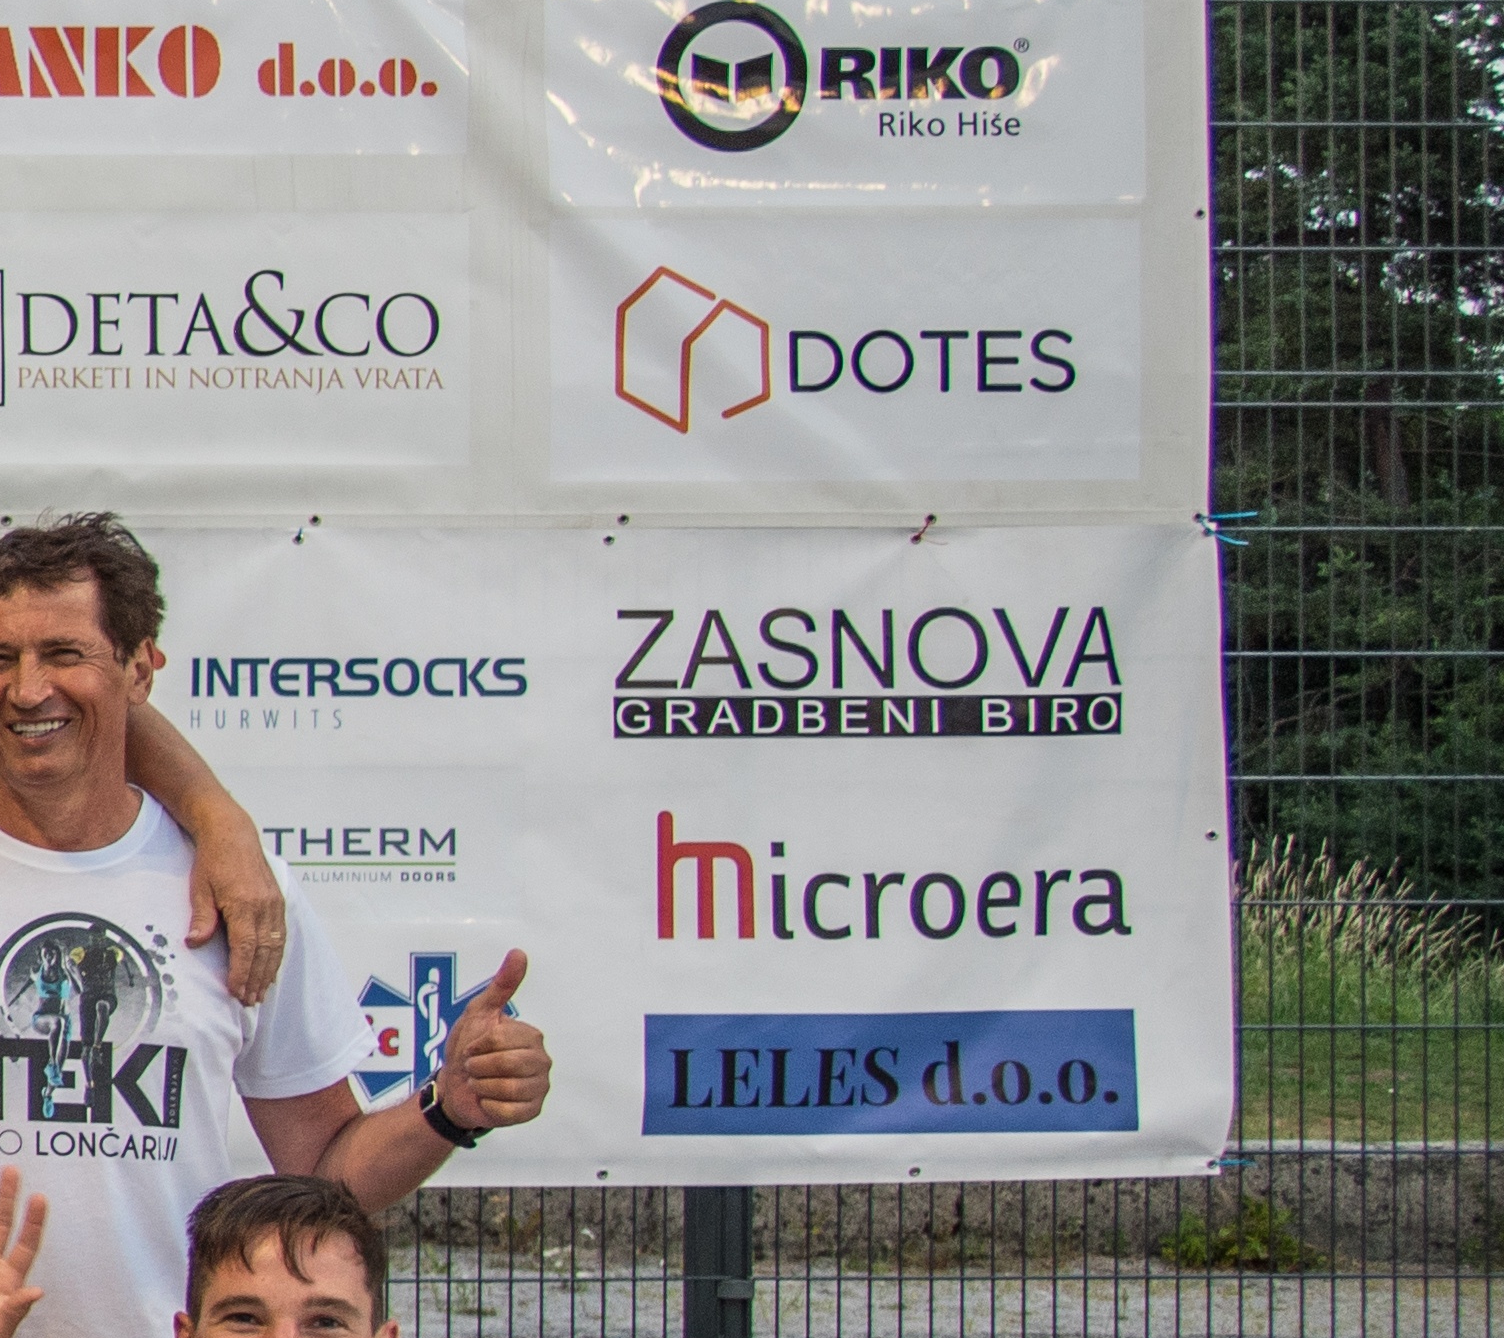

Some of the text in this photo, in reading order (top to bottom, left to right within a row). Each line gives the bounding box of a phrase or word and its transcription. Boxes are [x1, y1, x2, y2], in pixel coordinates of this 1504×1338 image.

[257, 42, 439, 99] d.o.o.
[878, 111, 1022, 138] Riko Hiše
[15, 269, 441, 358] DETA&CO
[16, 366, 445, 395] PARKETI IN NOTRANJA VRATA
[788, 329, 1077, 393] DOTES
[614, 606, 1123, 691] ZASNOVA
[190, 656, 529, 698] INTERSOCKS
[189, 708, 344, 730] HURWITS
[615, 696, 1120, 736] GRADBENI BIRO
[301, 871, 457, 883] ALUMINIUM DOORS
[667, 1040, 1120, 1109] LELES d.o.o.
[35, 1127, 178, 1162] LONČARIJI
